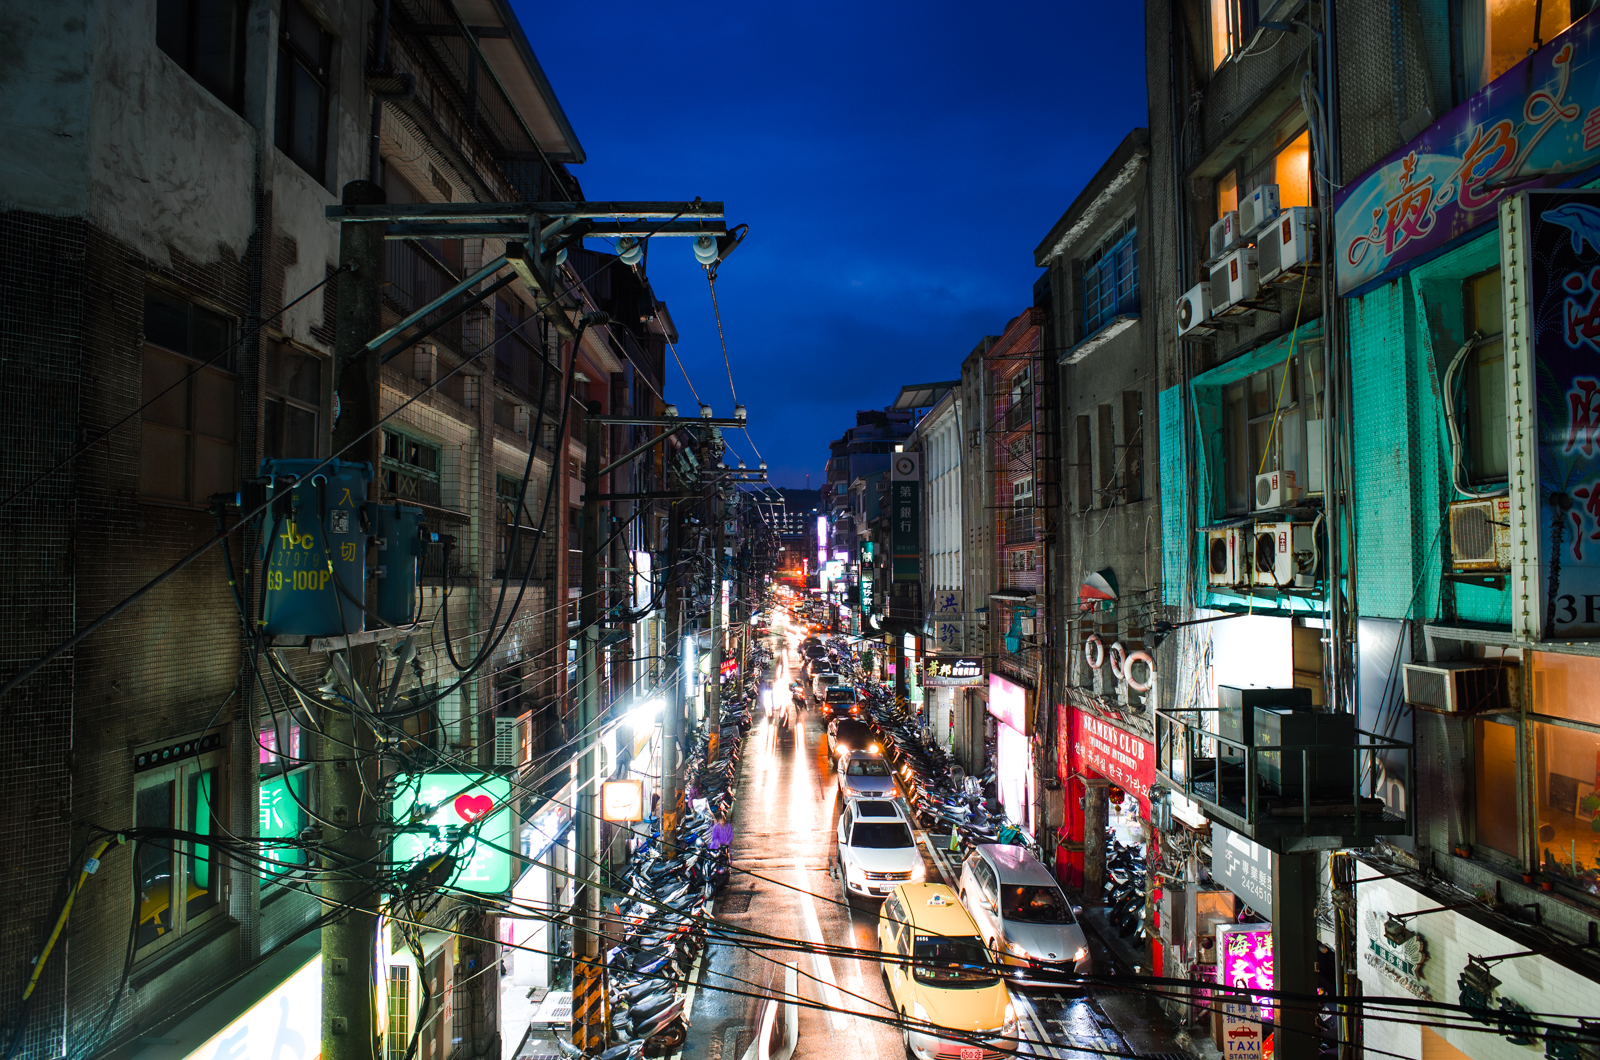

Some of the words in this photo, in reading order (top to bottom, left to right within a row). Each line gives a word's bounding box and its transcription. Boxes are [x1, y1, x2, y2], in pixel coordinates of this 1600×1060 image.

[338, 487, 355, 508] 入
[900, 485, 912, 533] 第一銀行
[280, 533, 314, 550] TPC
[340, 541, 356, 562] 切
[1083, 714, 1117, 746] SEAMEN'S
[1119, 733, 1144, 761] CLUB
[1087, 749, 1106, 772] 휴게실
[1108, 762, 1123, 781] 한국
[1112, 748, 1138, 771] INTERNET)
[1225, 848, 1233, 860] 2F
[1227, 1041, 1260, 1051] TAXI
